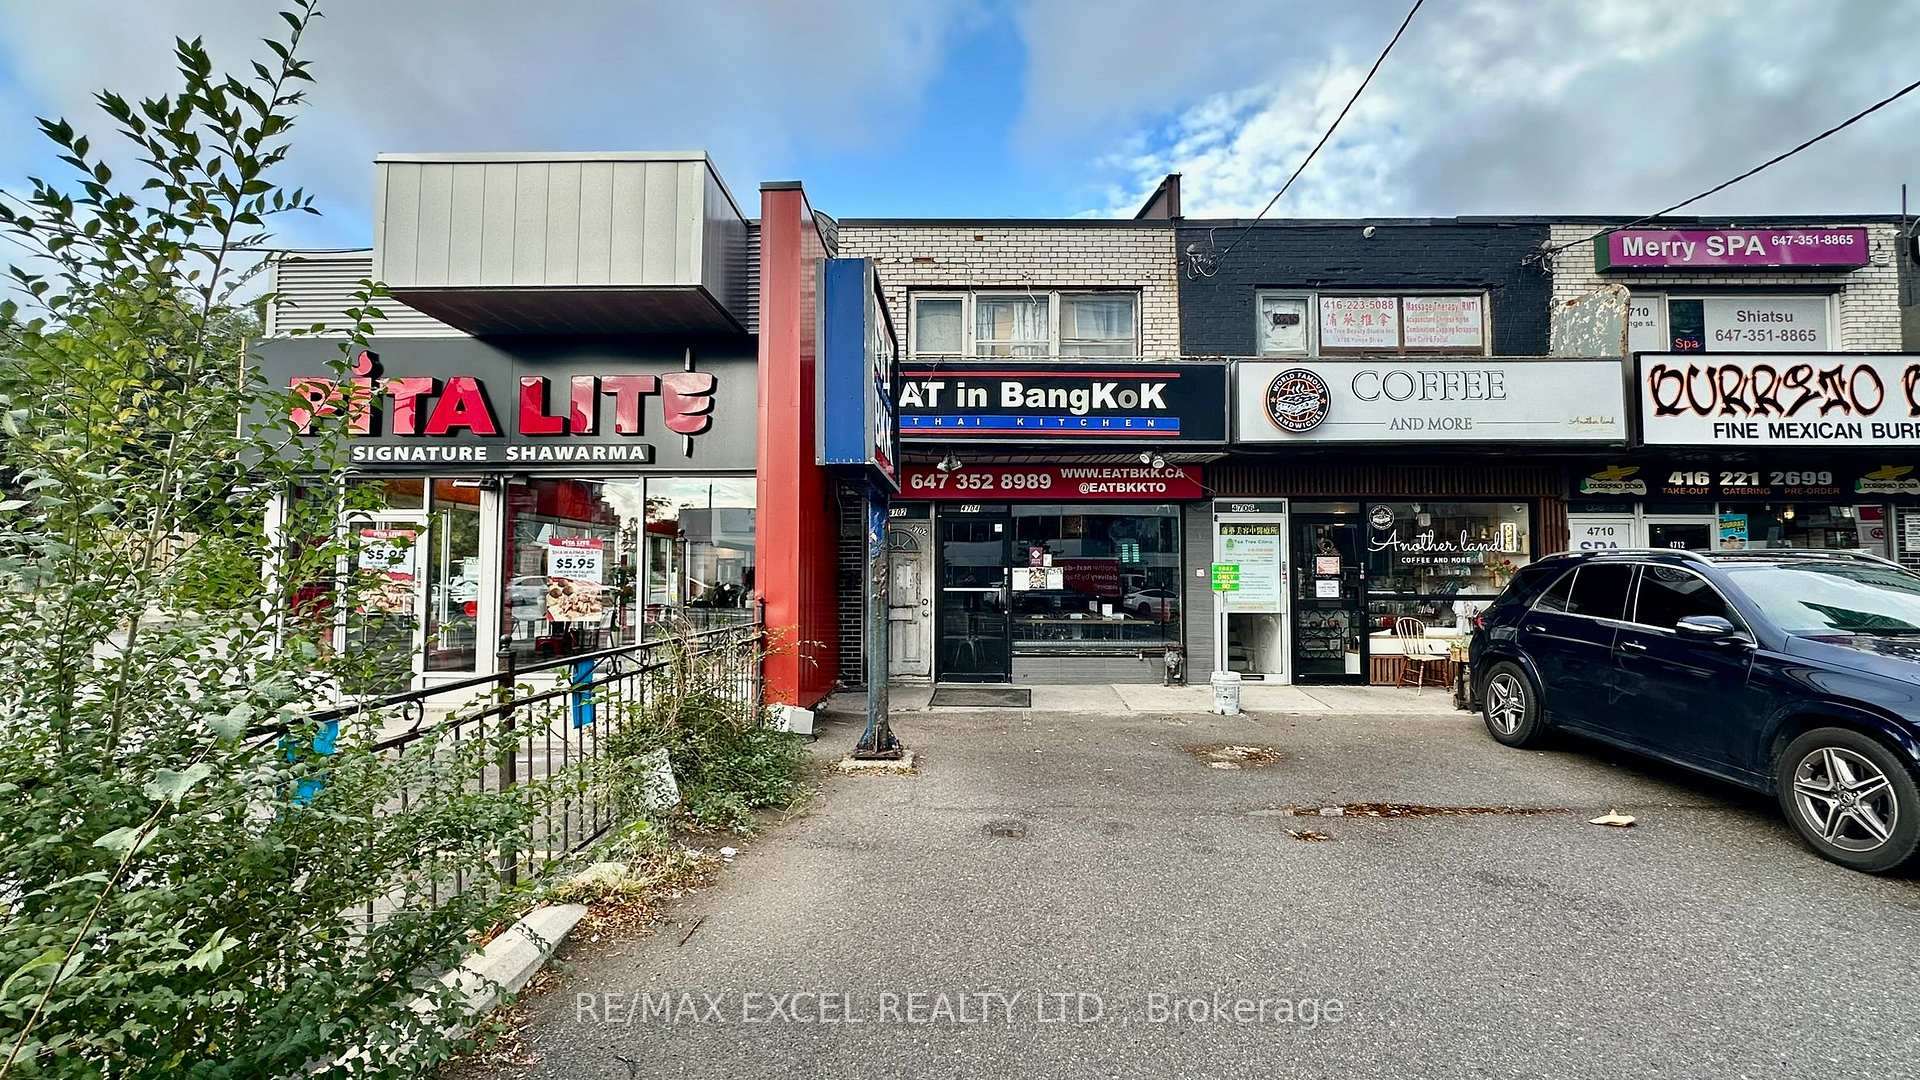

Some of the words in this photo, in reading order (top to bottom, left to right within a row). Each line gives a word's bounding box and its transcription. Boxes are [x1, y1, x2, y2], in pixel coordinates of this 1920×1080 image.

[1622, 236, 1696, 261] Merry
[1706, 235, 1766, 257] SPA
[1771, 234, 1854, 246] 647-351-8865
[1323, 300, 1395, 310] 416-223-5088
[1629, 307, 1649, 317] 710
[1736, 310, 1794, 323] Shiatsu
[1715, 329, 1817, 342] 647-351-8865
[1674, 337, 1699, 350] Spa
[1272, 373, 1295, 393] WORLD
[1298, 372, 1325, 394] FAMOUS
[1351, 369, 1507, 401] COFFEE
[1647, 362, 1885, 418] BURRITO
[899, 381, 945, 408] AT
[956, 381, 988, 408] in
[1000, 381, 1168, 416] BangKoK
[912, 417, 981, 426] THAI
[1015, 417, 1156, 428] KITCHEN
[1274, 411, 1324, 430] SANDWICHES
[1389, 417, 1424, 431] AND
[1428, 416, 1473, 431] MORE
[1713, 422, 1760, 439] FINE
[1768, 422, 1863, 439] MEXICAN
[352, 446, 488, 462] SIGNATURE
[505, 446, 646, 462] SHAWARMA
[1060, 467, 1185, 479] WWW.EATBKK.CA
[1668, 471, 1710, 486] 416
[1719, 471, 1760, 486] 221
[1769, 471, 1833, 486] 2699
[910, 473, 949, 490] 647
[955, 473, 994, 490] 352
[1000, 473, 1052, 490] 8989
[1078, 482, 1167, 495] @EATBKKTO
[1662, 487, 1710, 495] TAKE-OUT
[1722, 487, 1771, 495] CATERING
[1783, 487, 1841, 496] PRE-ORDER
[1586, 527, 1615, 536] 4710
[1367, 528, 1457, 552] Another
[1460, 529, 1502, 552] land
[1669, 540, 1686, 549] 4712
[367, 549, 408, 560] $5.95
[1401, 556, 1431, 564] COFFEE
[1433, 556, 1449, 564] AND
[1451, 556, 1471, 564] MORE
[556, 558, 595, 569] $5.95
